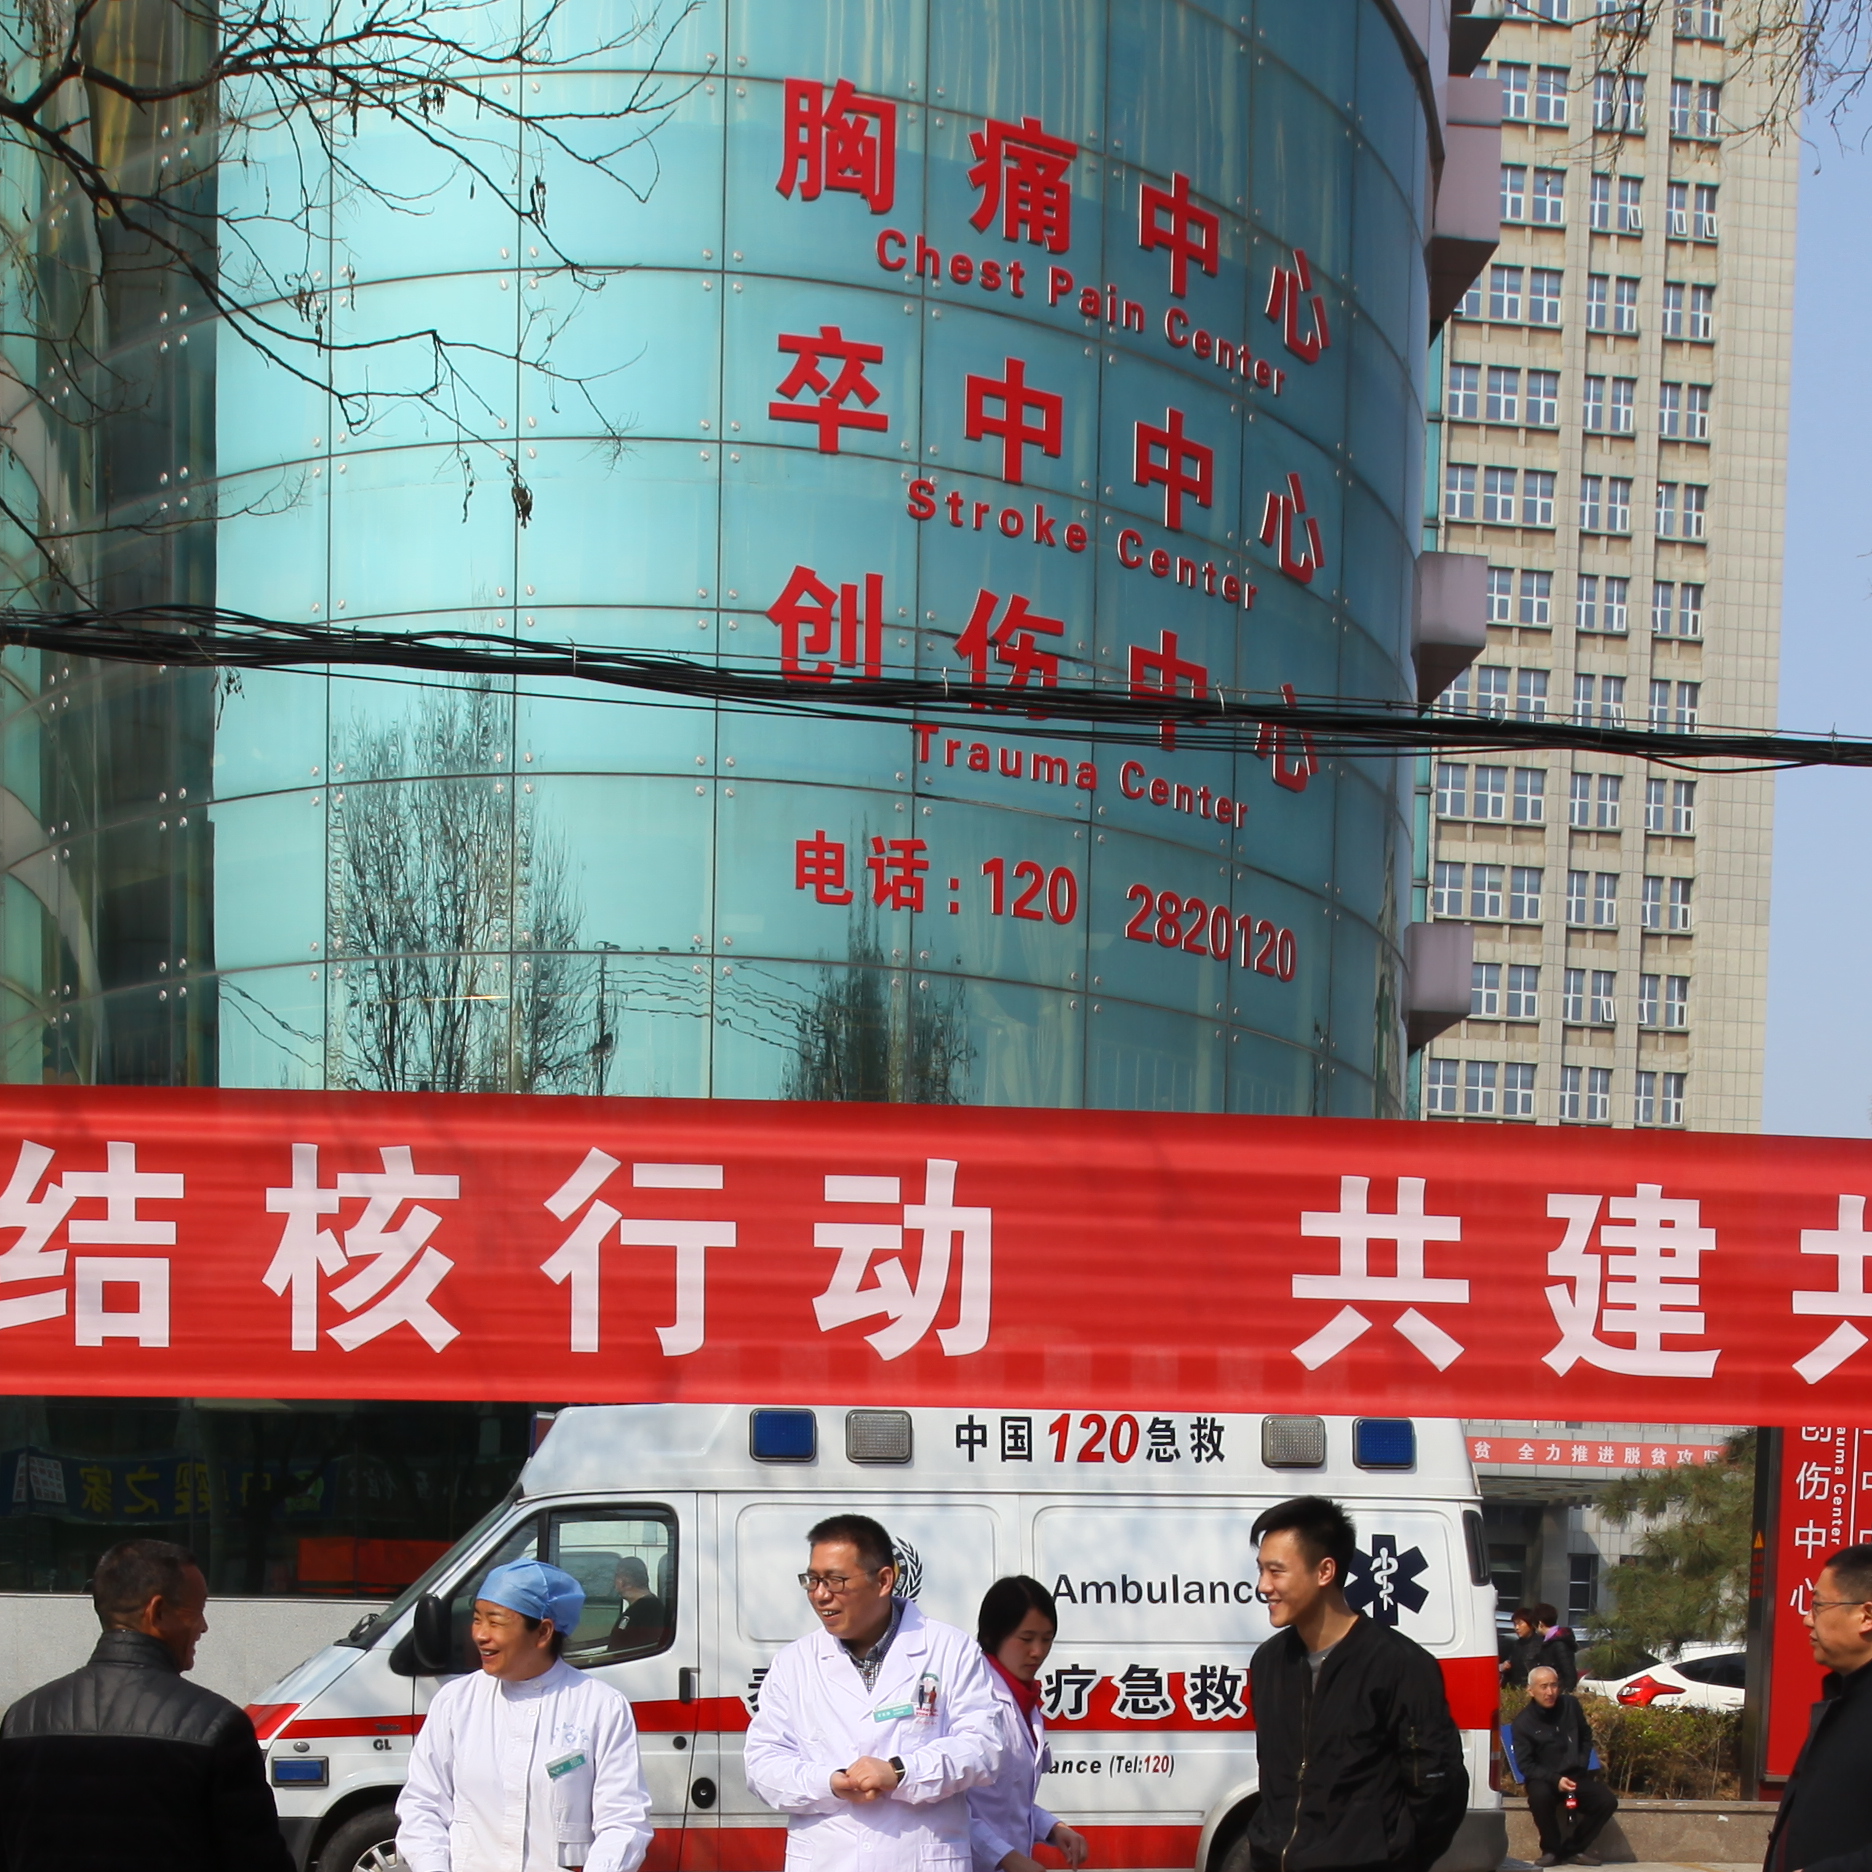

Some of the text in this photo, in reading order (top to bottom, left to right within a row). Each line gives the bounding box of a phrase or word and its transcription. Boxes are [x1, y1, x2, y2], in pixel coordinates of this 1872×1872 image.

[775, 77, 1330, 365] 胸痛中心
[875, 230, 1287, 398] Chest Pain Center
[768, 326, 1325, 585] 卒中中心
[906, 480, 1259, 610] Stroke Center
[766, 564, 1320, 793] 创伤中心
[911, 722, 1249, 829] Trauma Center
[1124, 884, 1298, 985] 2820120
[955, 1413, 1226, 1463] 中国120急救
[1831, 1483, 1846, 1545] Center
[373, 1738, 392, 1751] GL
[1109, 1755, 1175, 1777] (Tel:120)
